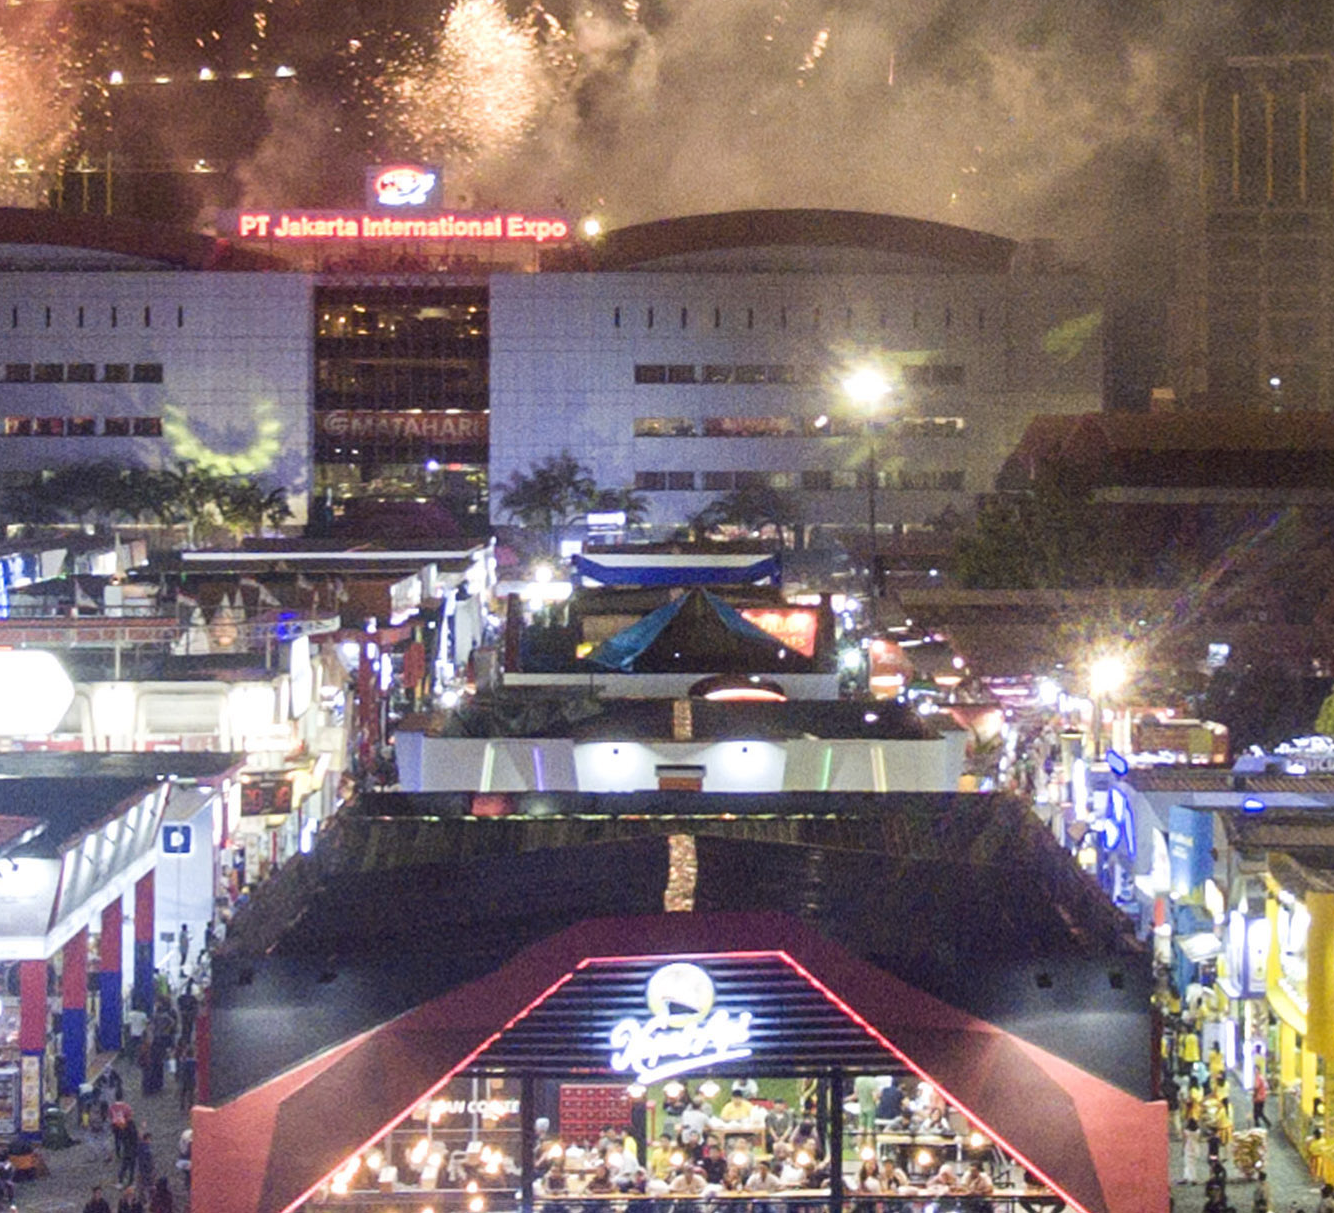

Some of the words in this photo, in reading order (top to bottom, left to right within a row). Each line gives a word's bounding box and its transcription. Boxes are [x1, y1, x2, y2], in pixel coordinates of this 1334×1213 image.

[239, 215, 270, 237] PT
[274, 215, 358, 238] Jakarta
[362, 215, 502, 238] International
[507, 215, 568, 241] Expo
